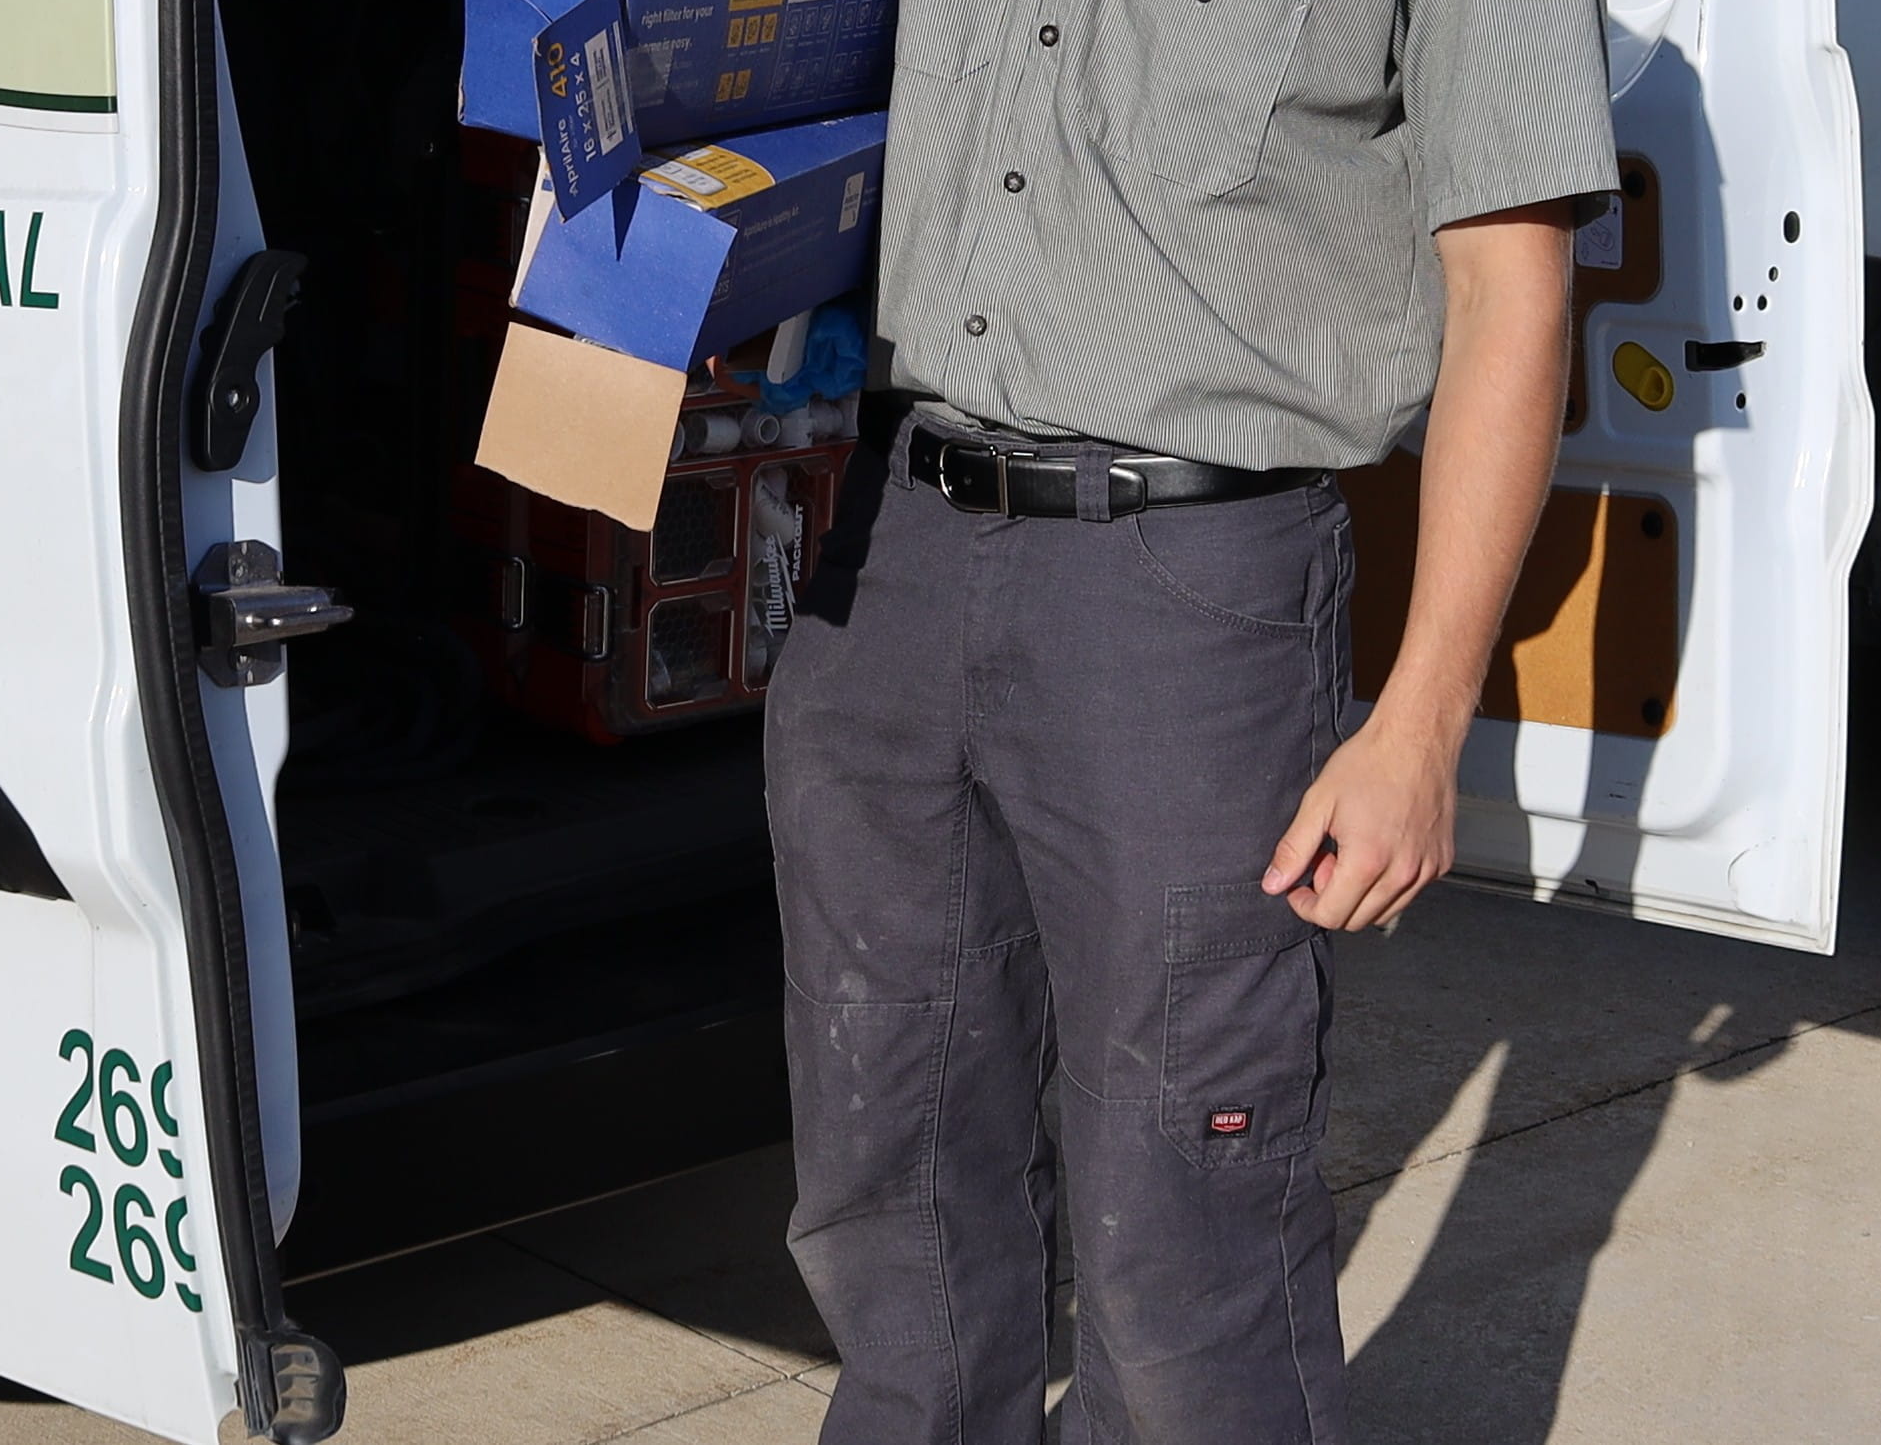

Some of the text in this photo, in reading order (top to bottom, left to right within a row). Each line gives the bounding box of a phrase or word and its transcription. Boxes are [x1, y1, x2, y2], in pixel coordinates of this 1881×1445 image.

[641, 9, 662, 26] right
[695, 4, 714, 21] your
[547, 42, 568, 98] 410
[570, 52, 597, 162] 16 x 25 x 4
[557, 119, 580, 197] AprilAire
[792, 504, 804, 581] PACKOUT
[764, 534, 790, 638] Milwaukee
